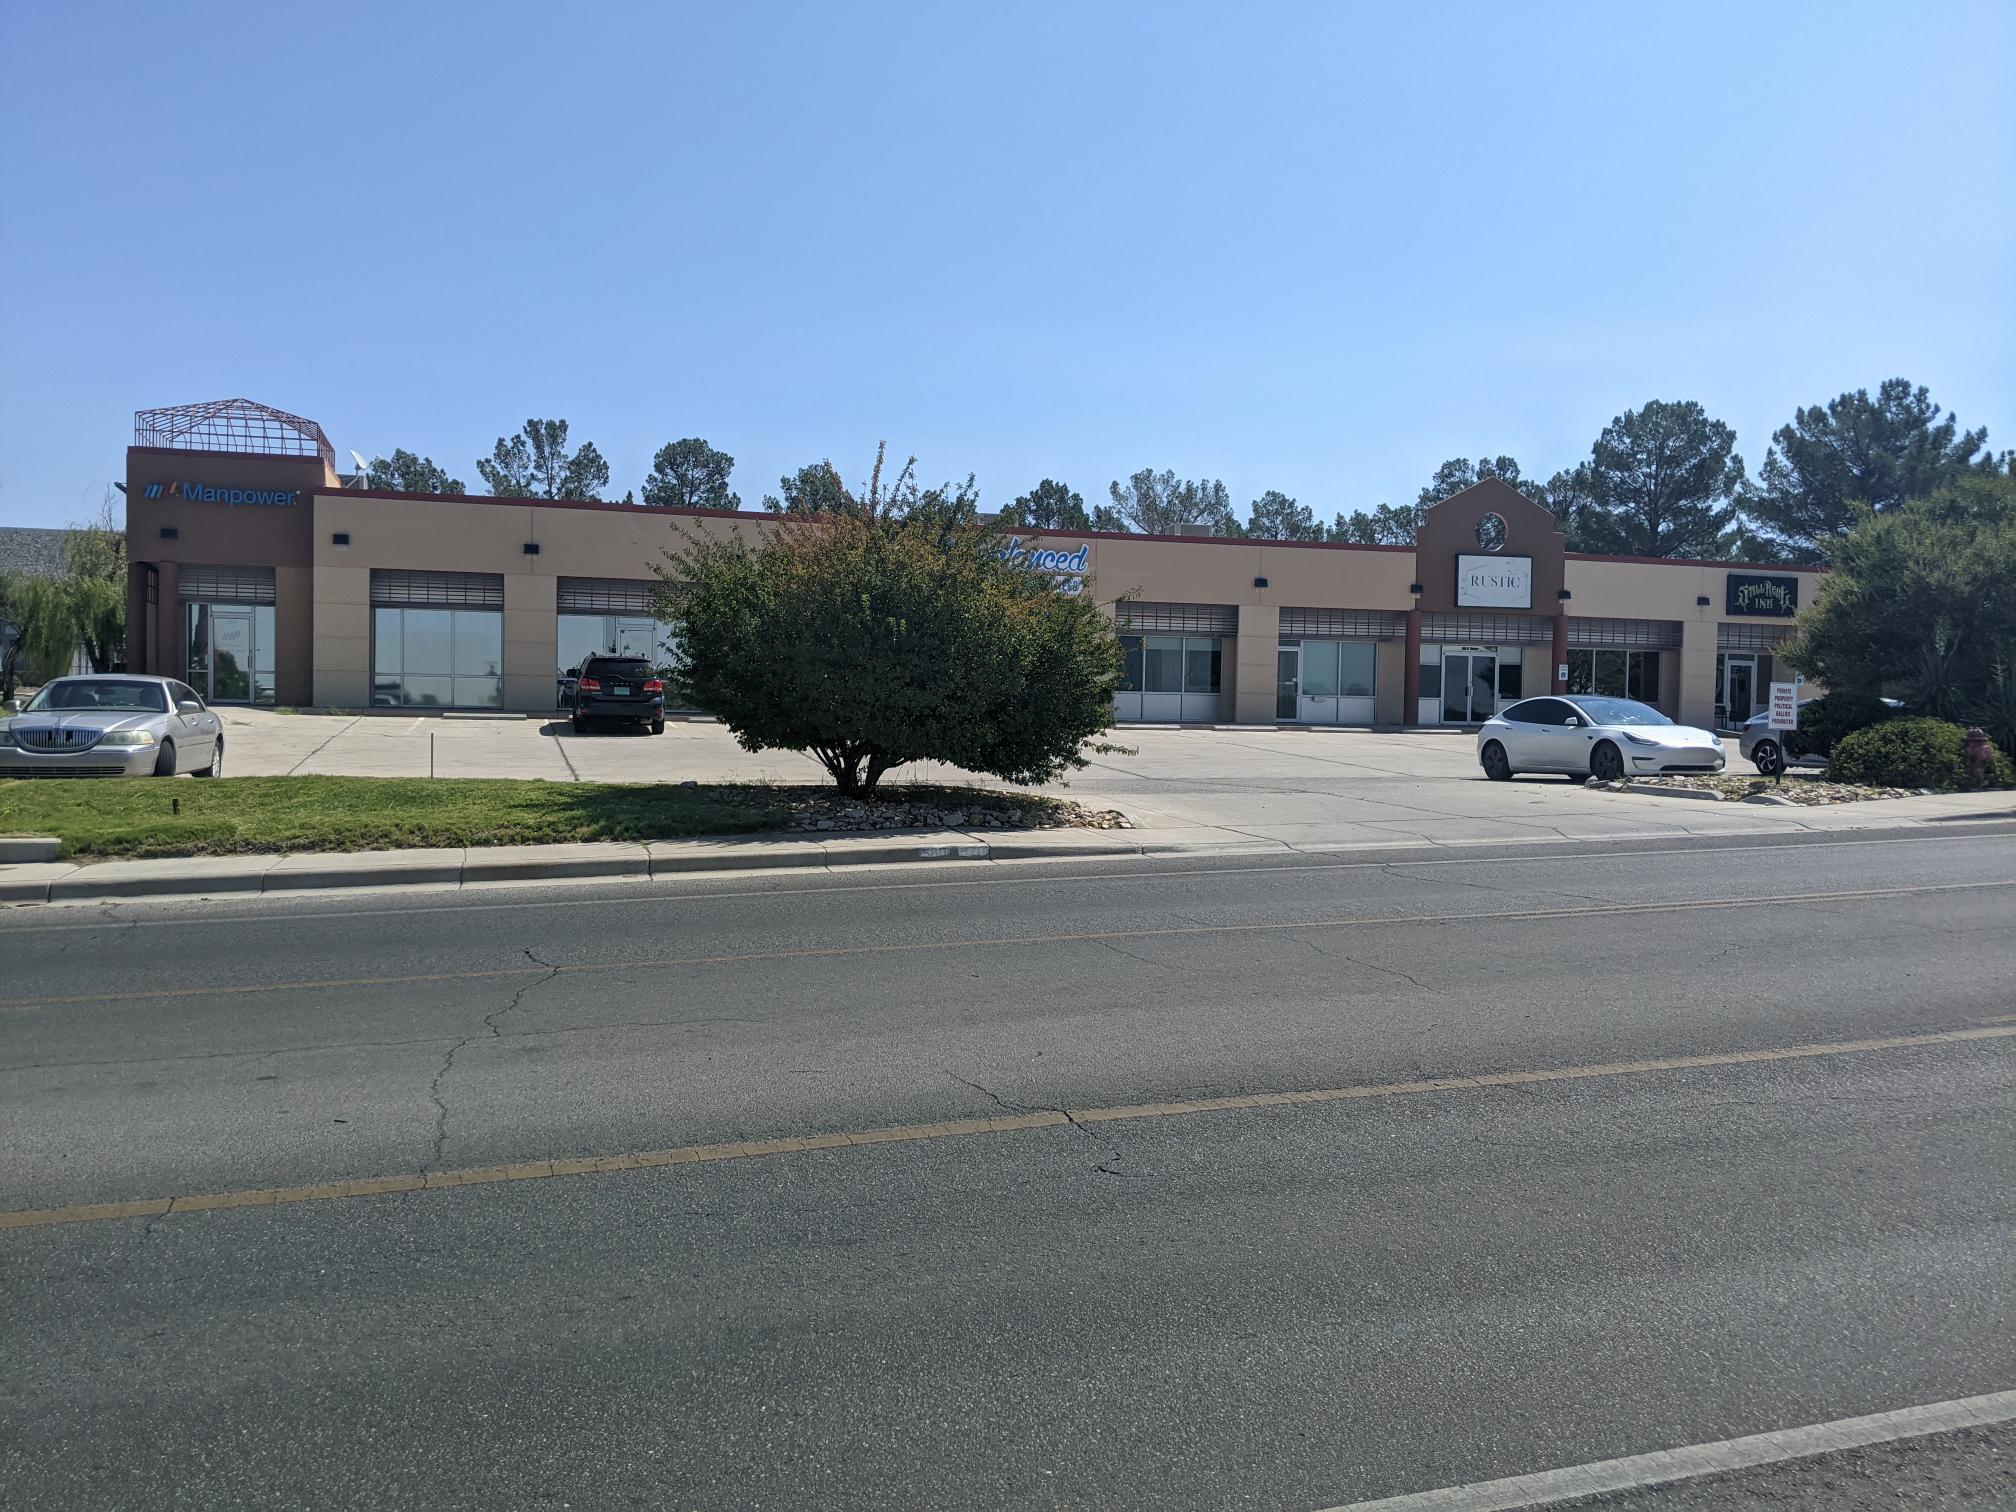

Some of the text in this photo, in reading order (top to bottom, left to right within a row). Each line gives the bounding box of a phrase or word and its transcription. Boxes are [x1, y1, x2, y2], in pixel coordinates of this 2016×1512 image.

[183, 482, 296, 506] Manpower
[1471, 575, 1520, 588] RUSTIC
[1754, 598, 1774, 609] INK
